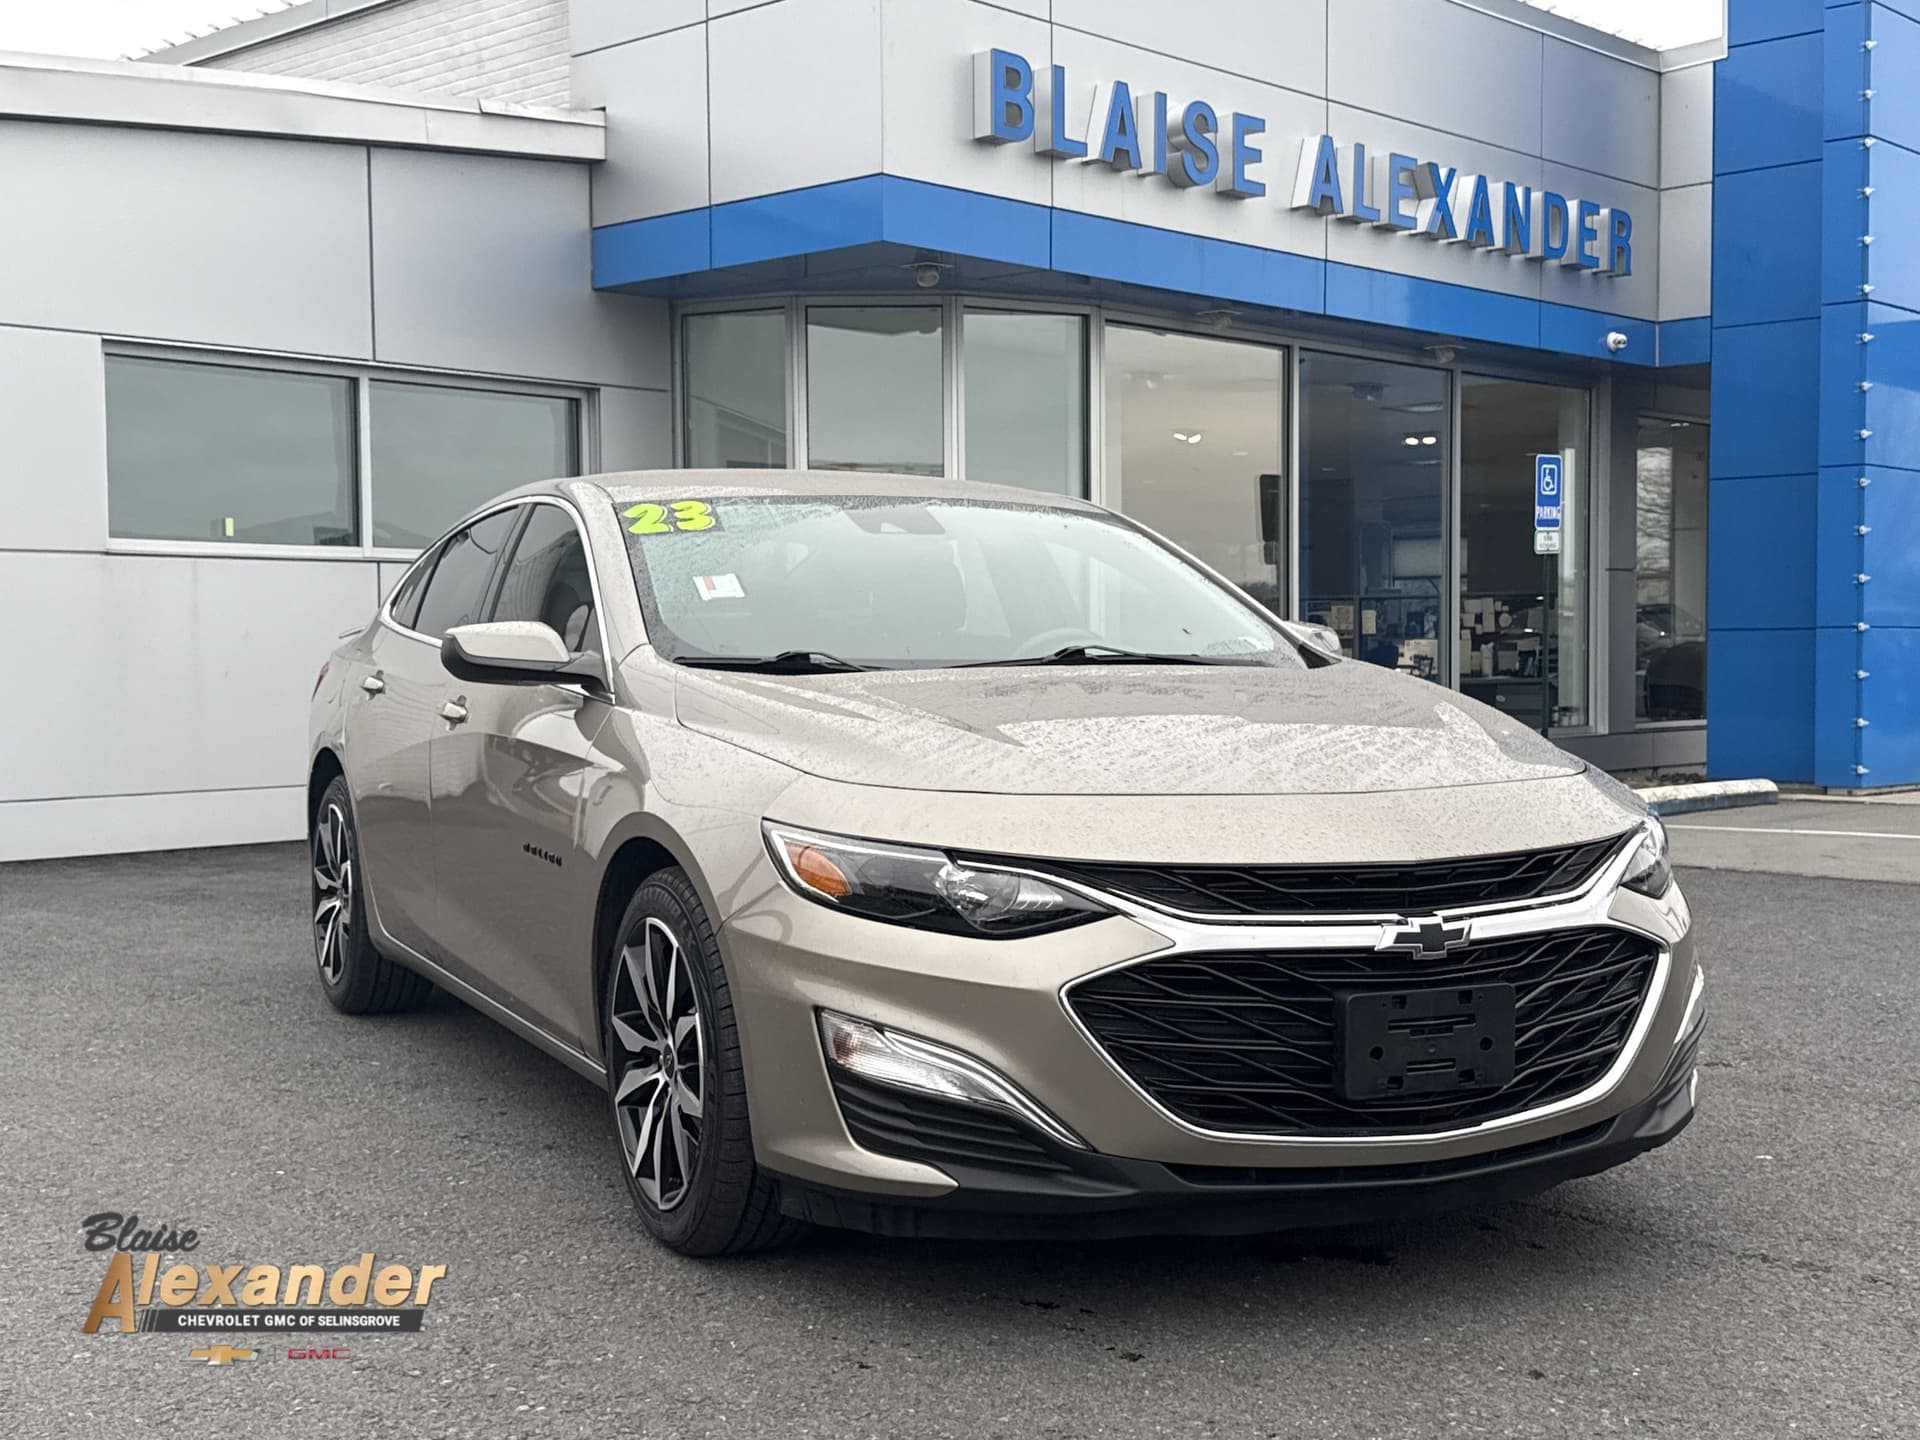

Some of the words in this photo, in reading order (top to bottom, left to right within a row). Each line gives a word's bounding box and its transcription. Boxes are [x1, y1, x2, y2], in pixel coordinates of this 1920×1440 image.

[974, 48, 1266, 199] BLAISE
[1293, 135, 1632, 276] ALEXANDER
[623, 500, 716, 534] 23
